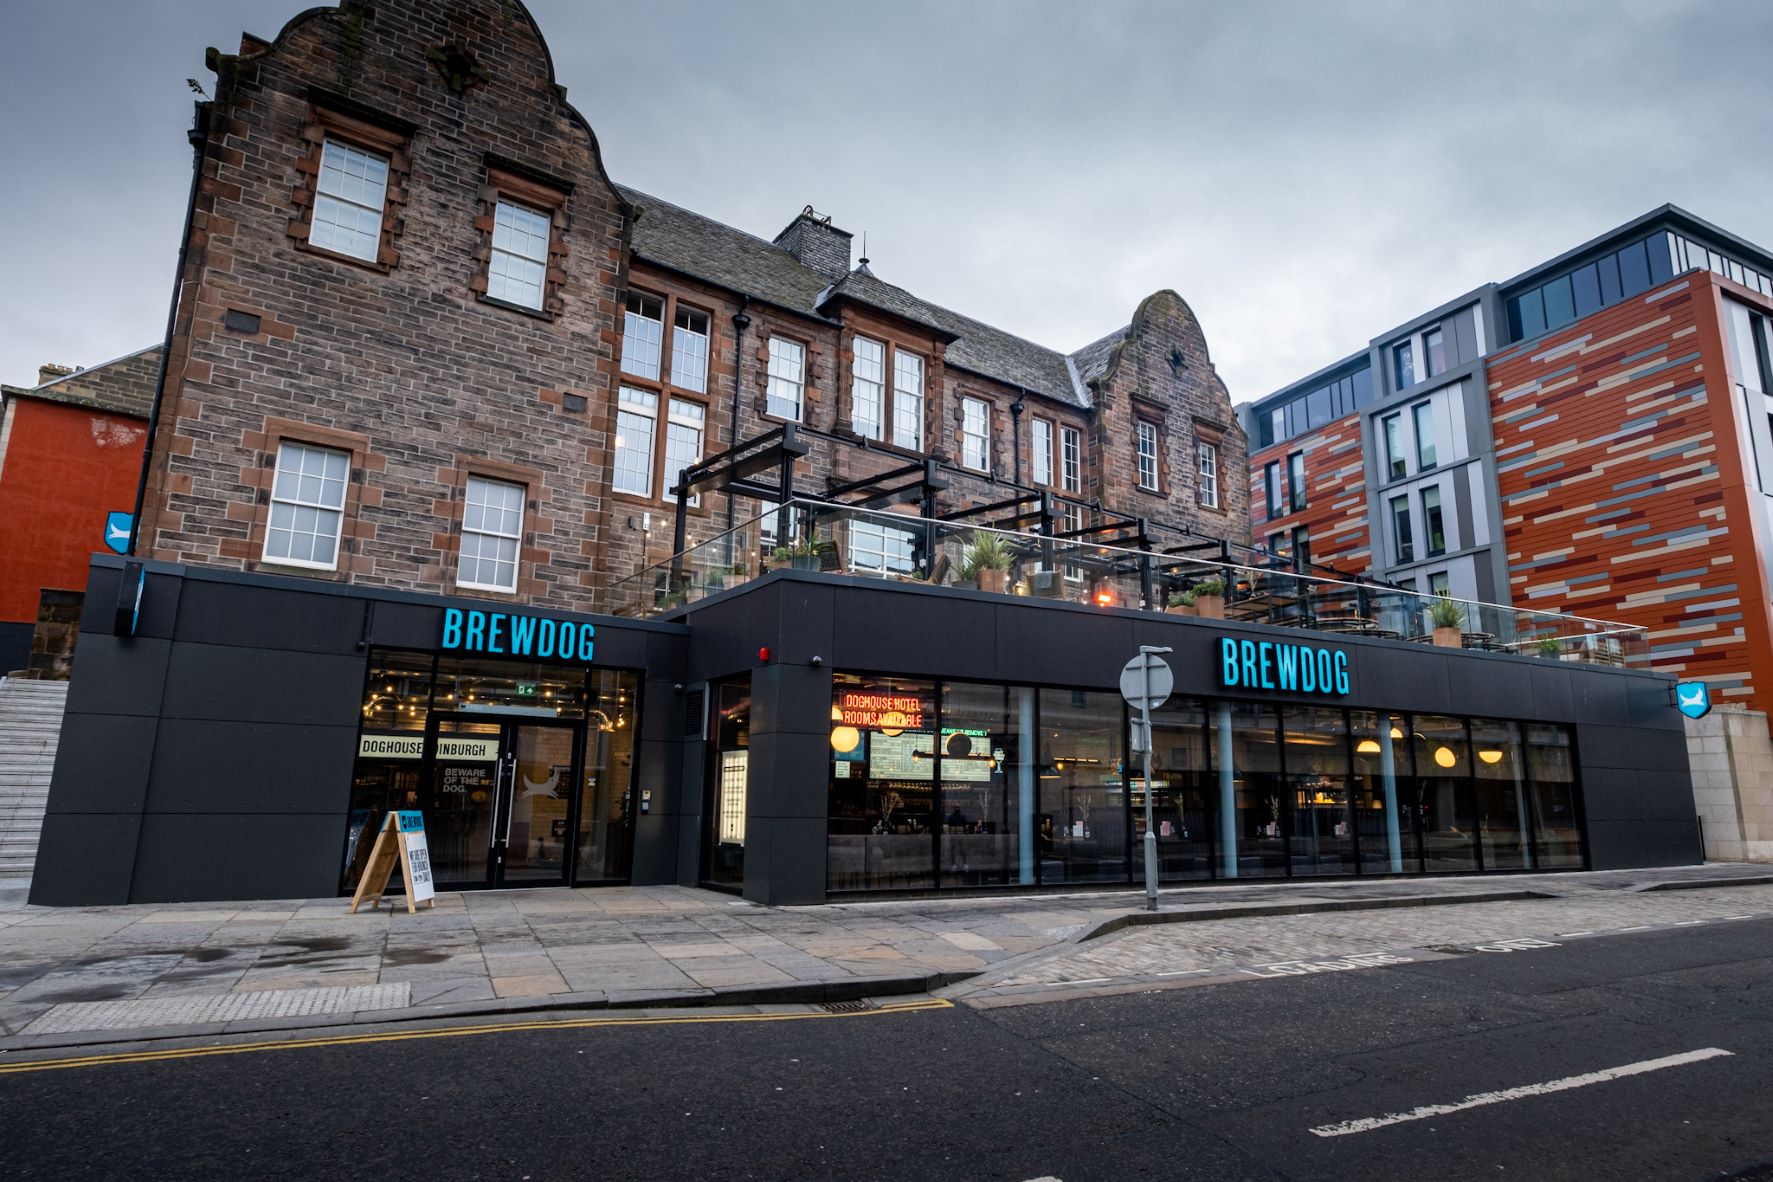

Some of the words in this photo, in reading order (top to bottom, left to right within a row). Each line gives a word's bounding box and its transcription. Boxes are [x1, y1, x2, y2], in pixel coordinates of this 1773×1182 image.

[442, 608, 595, 661] BREWDOG
[1222, 637, 1349, 695] BREWDOG
[846, 694, 893, 710] DOGHOUSE
[894, 698, 921, 712] HOTEL
[844, 711, 877, 725] ROOMS
[362, 740, 424, 754] DOGHOUSE
[437, 743, 486, 756] INBURGH
[444, 776, 458, 785] OF
[460, 776, 480, 785] THE
[445, 768, 486, 777] BEWARE
[443, 784, 468, 793] DOG.
[1240, 954, 1414, 978] LOADING
[1475, 938, 1562, 952] ONLY
